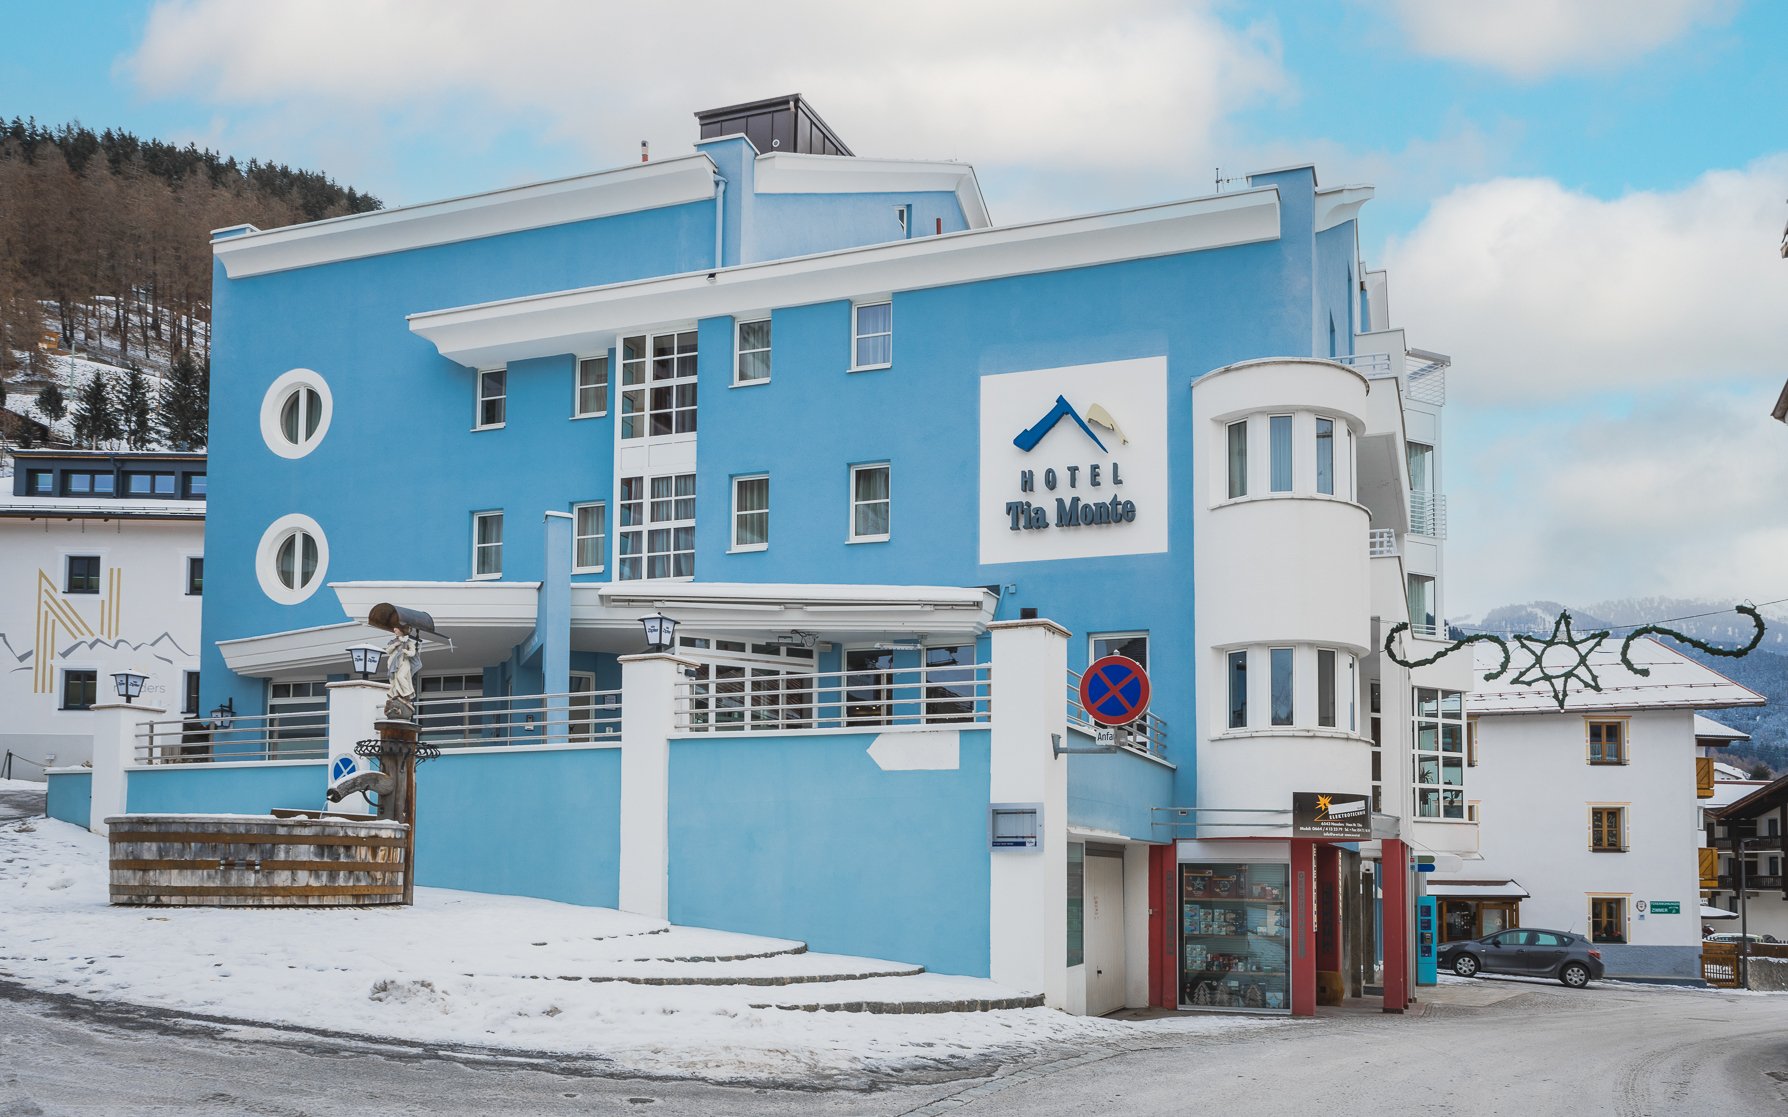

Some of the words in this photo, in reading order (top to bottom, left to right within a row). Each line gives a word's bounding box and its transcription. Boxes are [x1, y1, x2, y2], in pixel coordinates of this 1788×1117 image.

[1020, 462, 1123, 493] HOTEL
[1005, 500, 1050, 531] Tia
[1055, 493, 1136, 528] Monte
[113, 683, 166, 693] nders
[1329, 811, 1366, 820] ELEKTROTECHNIK
